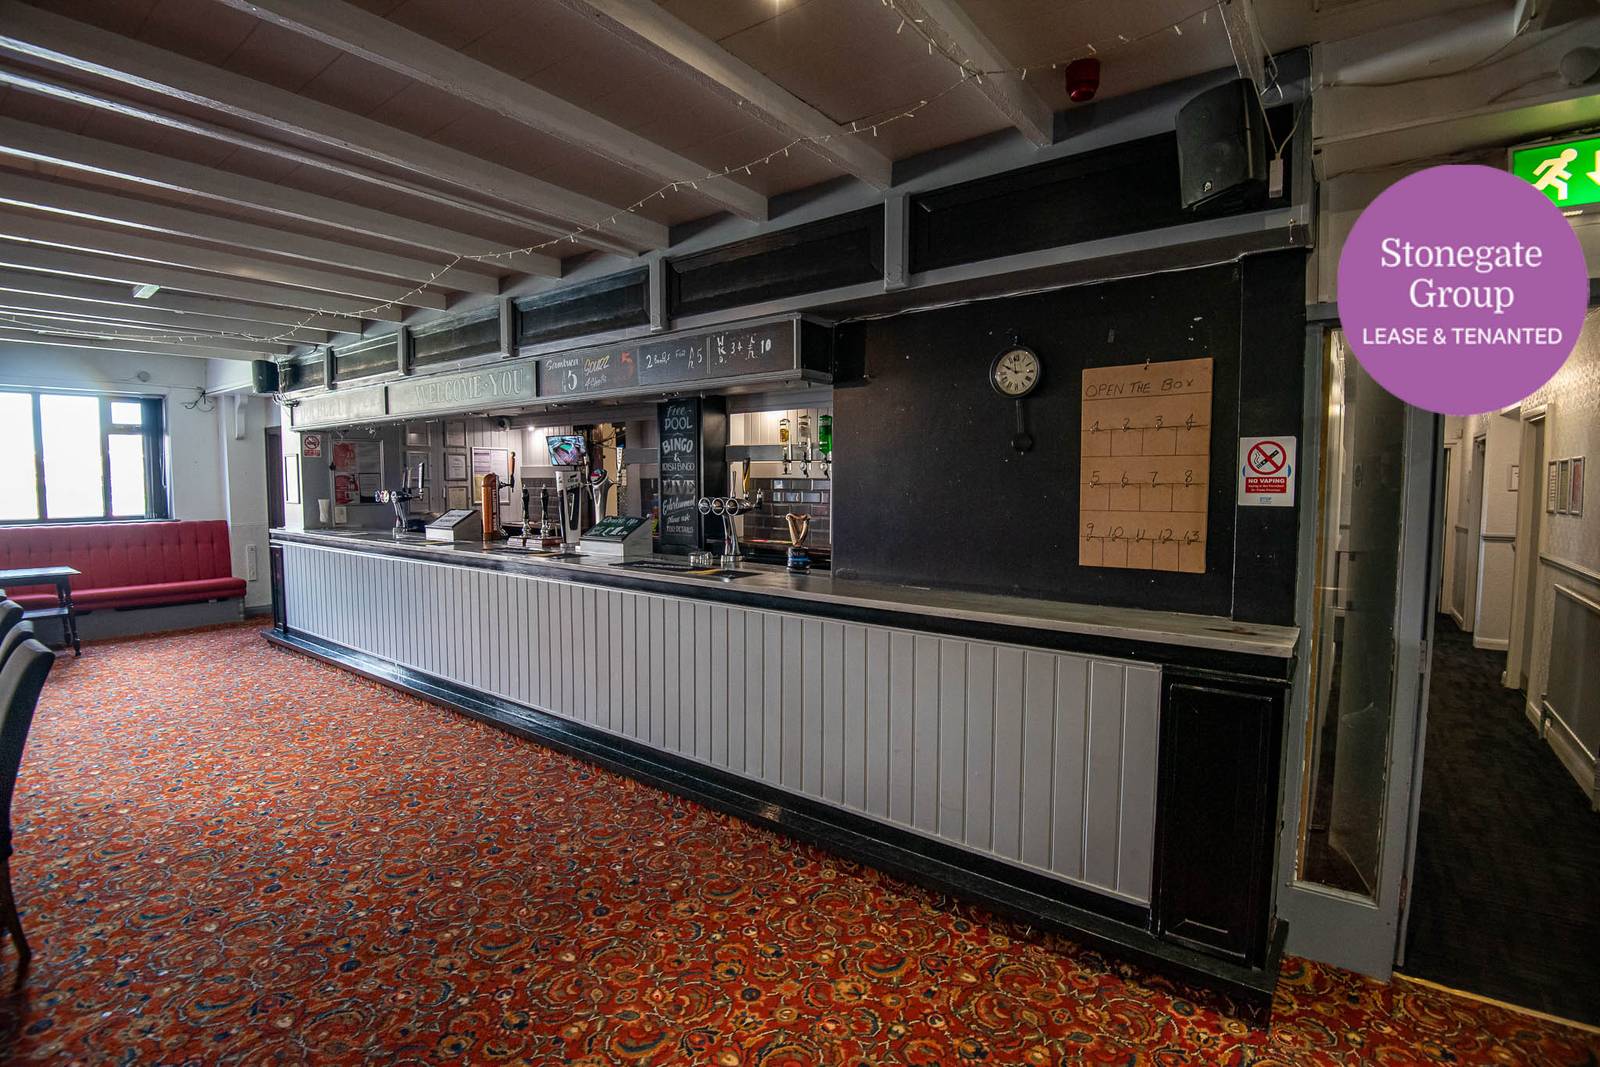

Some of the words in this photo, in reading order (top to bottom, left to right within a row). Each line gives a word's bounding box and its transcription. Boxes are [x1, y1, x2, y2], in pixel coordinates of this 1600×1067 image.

[415, 376, 482, 406] WELCOME
[489, 368, 524, 396] YOU
[1086, 383, 1125, 398] OPEN
[1130, 381, 1152, 394] THE
[1160, 378, 1194, 392] BOX
[664, 416, 694, 431] POOL
[662, 437, 694, 454] BINGO
[1090, 470, 1101, 484] 5
[1121, 472, 1129, 486] 6
[1148, 471, 1159, 486] 7
[1184, 469, 1194, 484] 8
